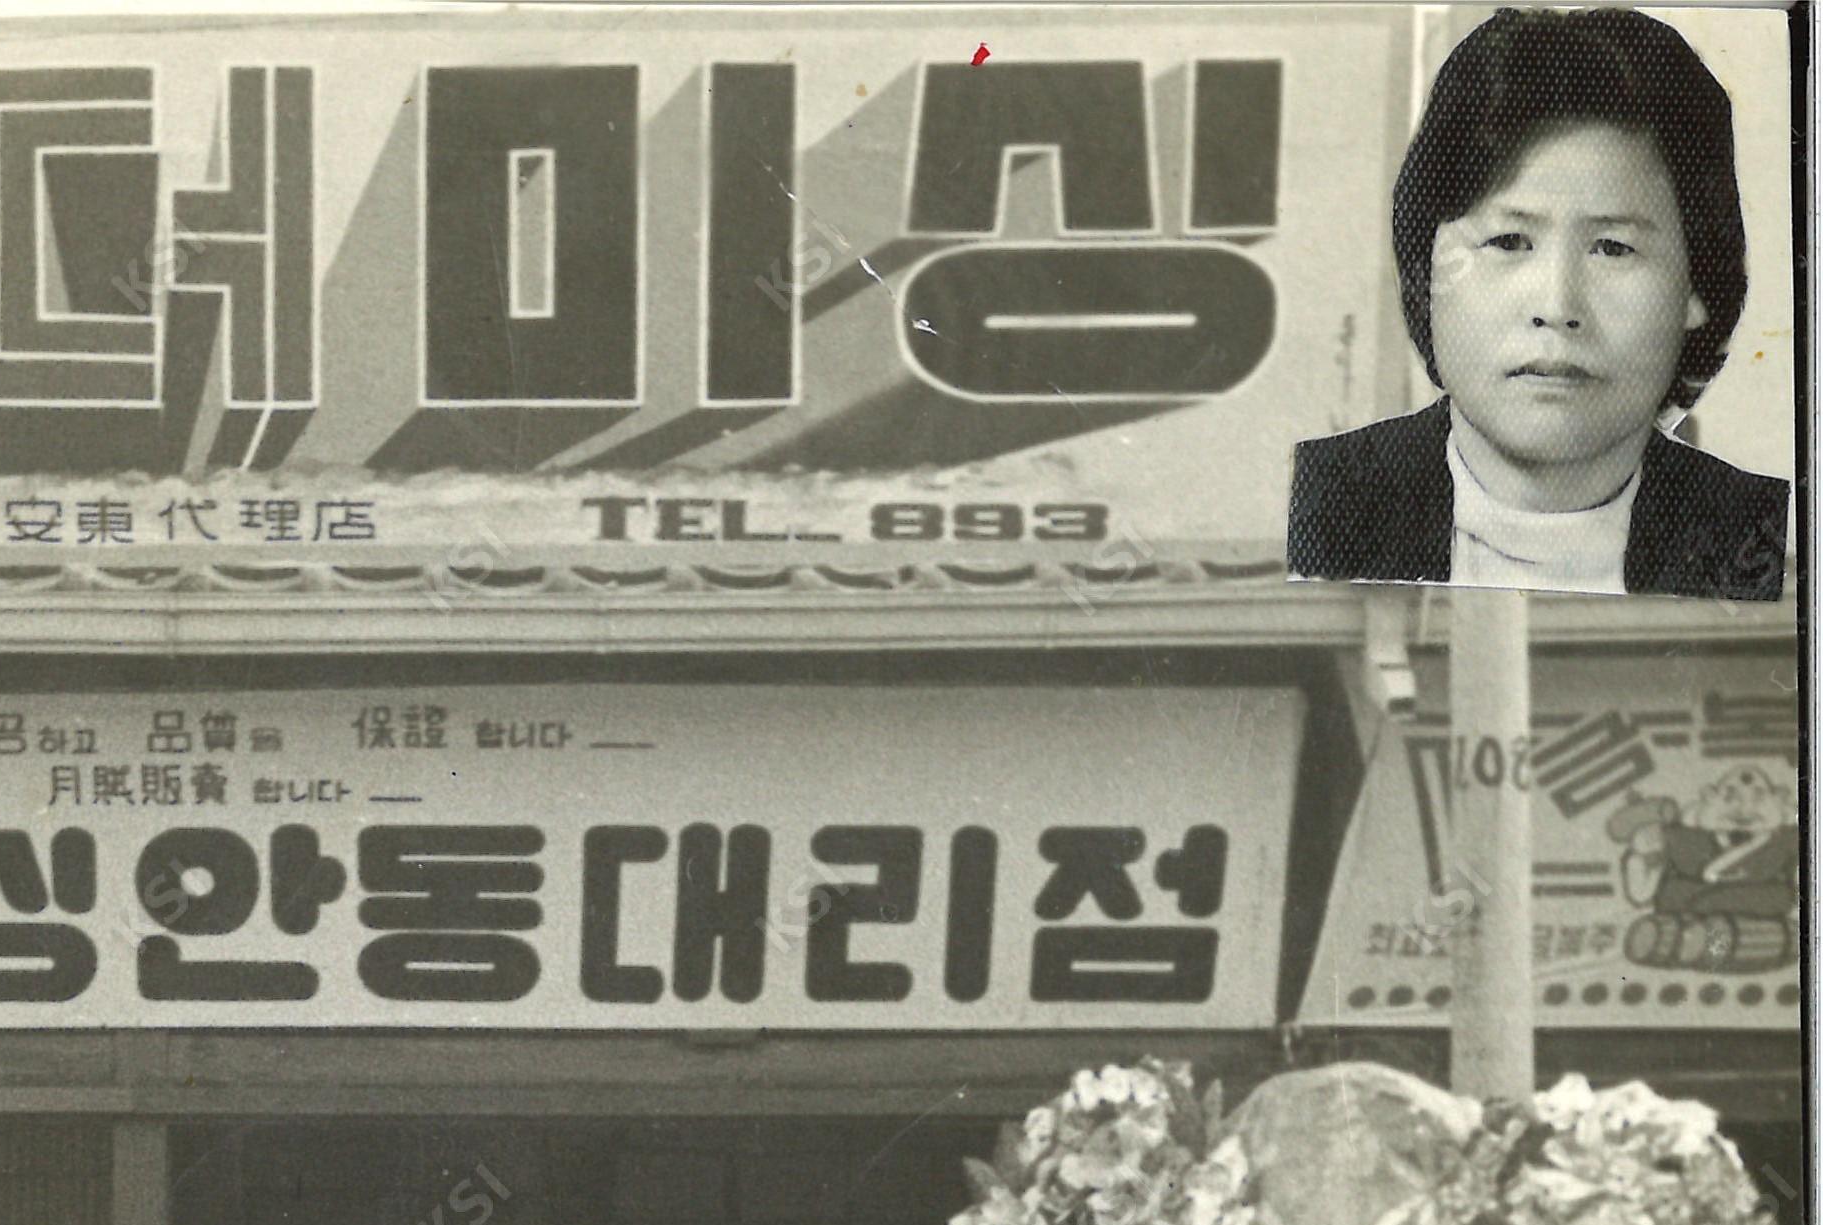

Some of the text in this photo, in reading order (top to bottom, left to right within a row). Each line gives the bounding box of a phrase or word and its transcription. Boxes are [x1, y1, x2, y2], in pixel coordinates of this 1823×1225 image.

[868, 500, 1109, 542] 893
[474, 719, 574, 751] 합니다
[252, 778, 353, 804] 합니다
